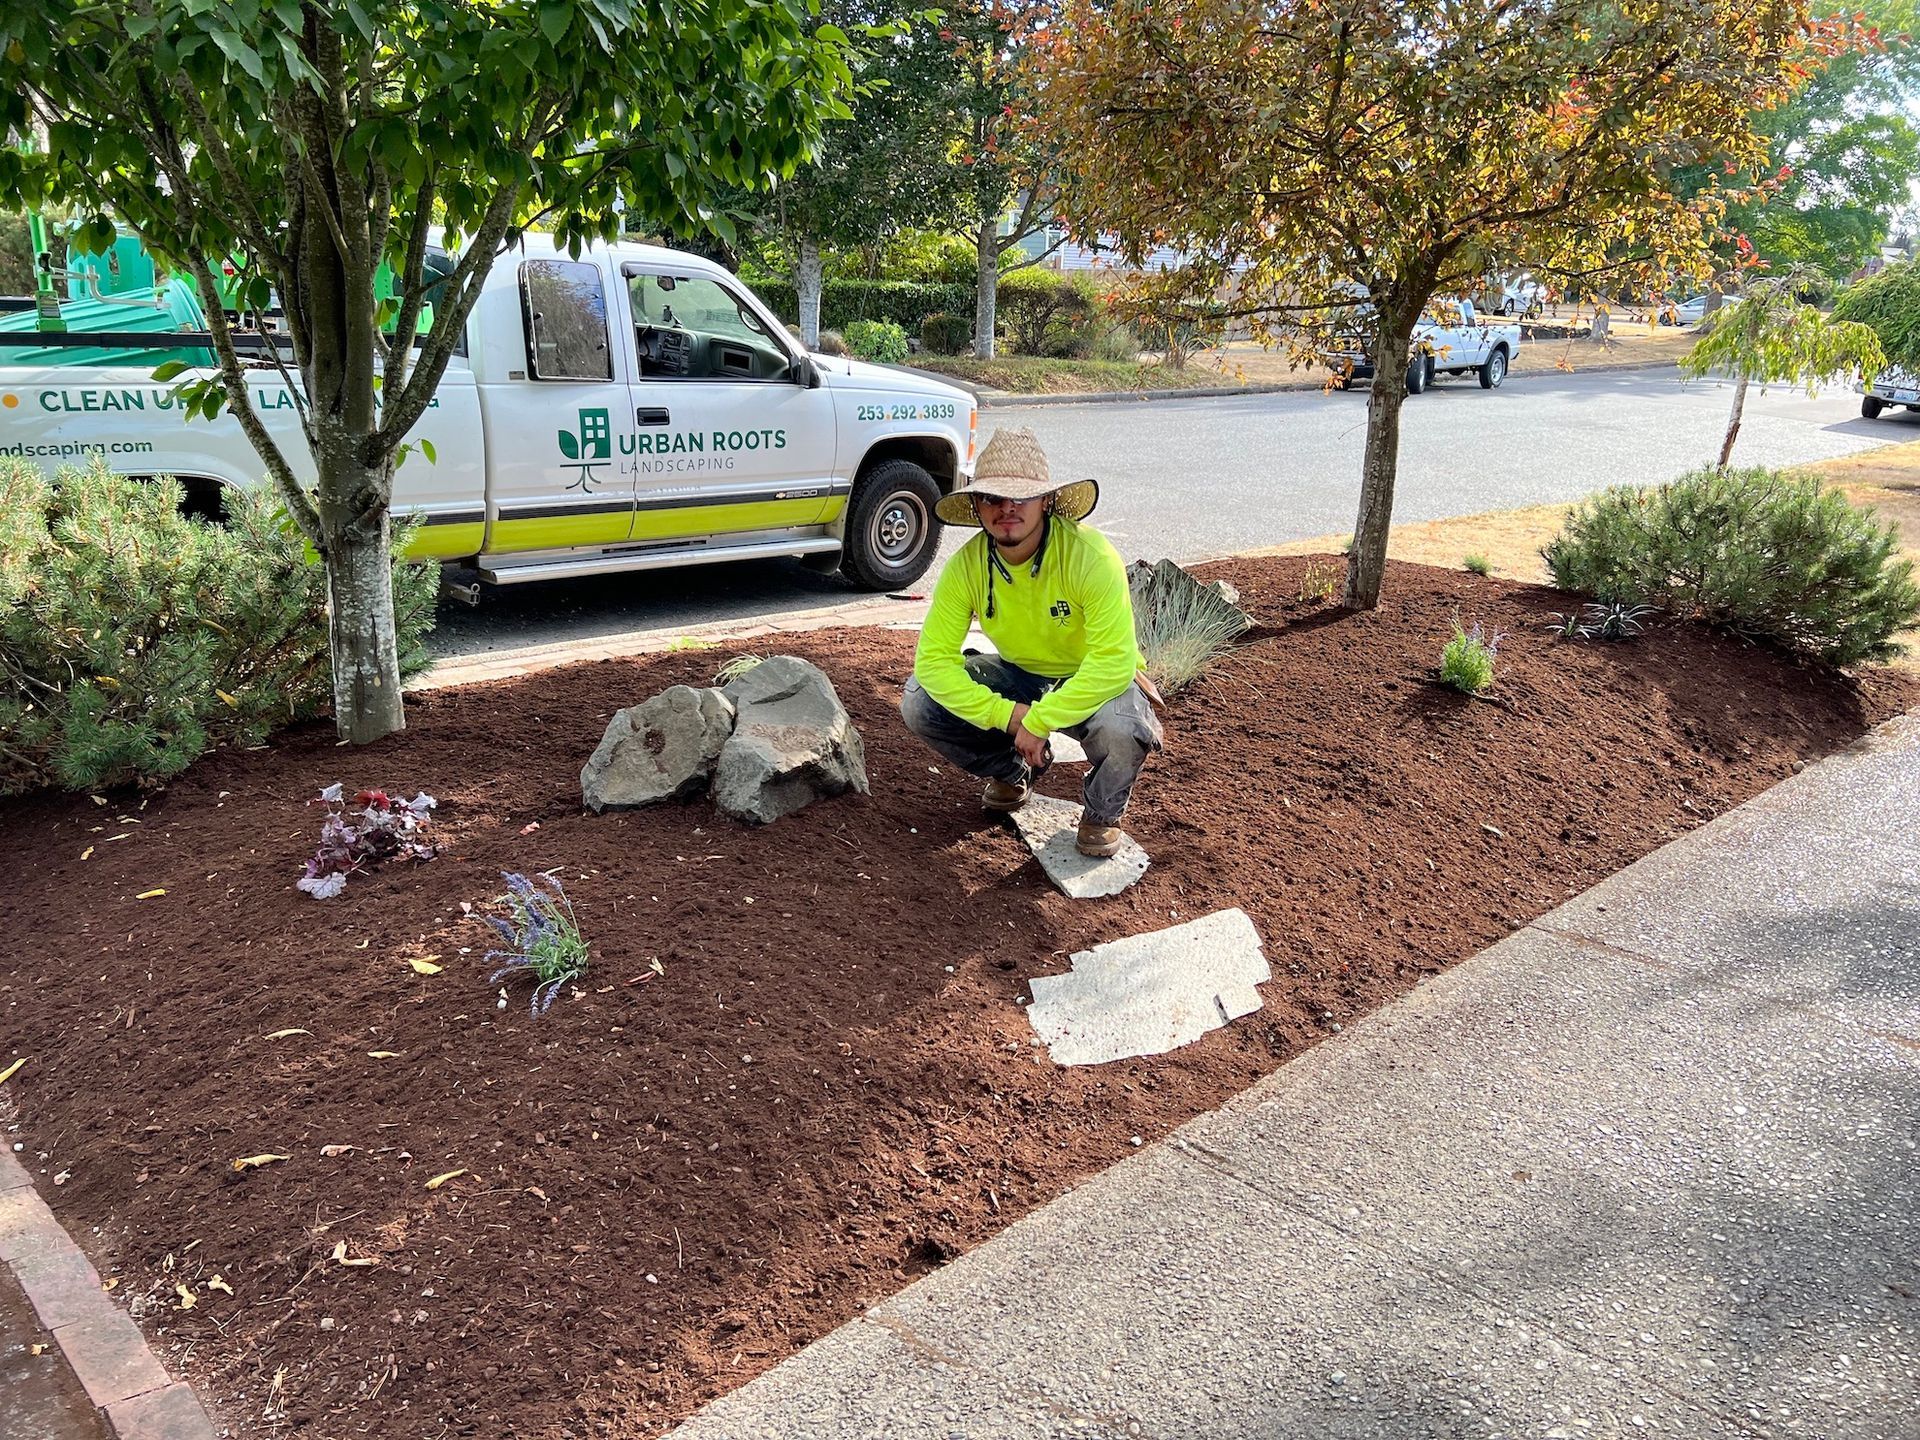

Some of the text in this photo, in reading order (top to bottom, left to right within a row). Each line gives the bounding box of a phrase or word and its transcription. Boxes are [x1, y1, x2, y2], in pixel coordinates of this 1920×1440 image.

[40, 390, 145, 412] CLEAN
[619, 430, 786, 455] URBAN ROOTS
[621, 457, 734, 474] LANDSCAPING
